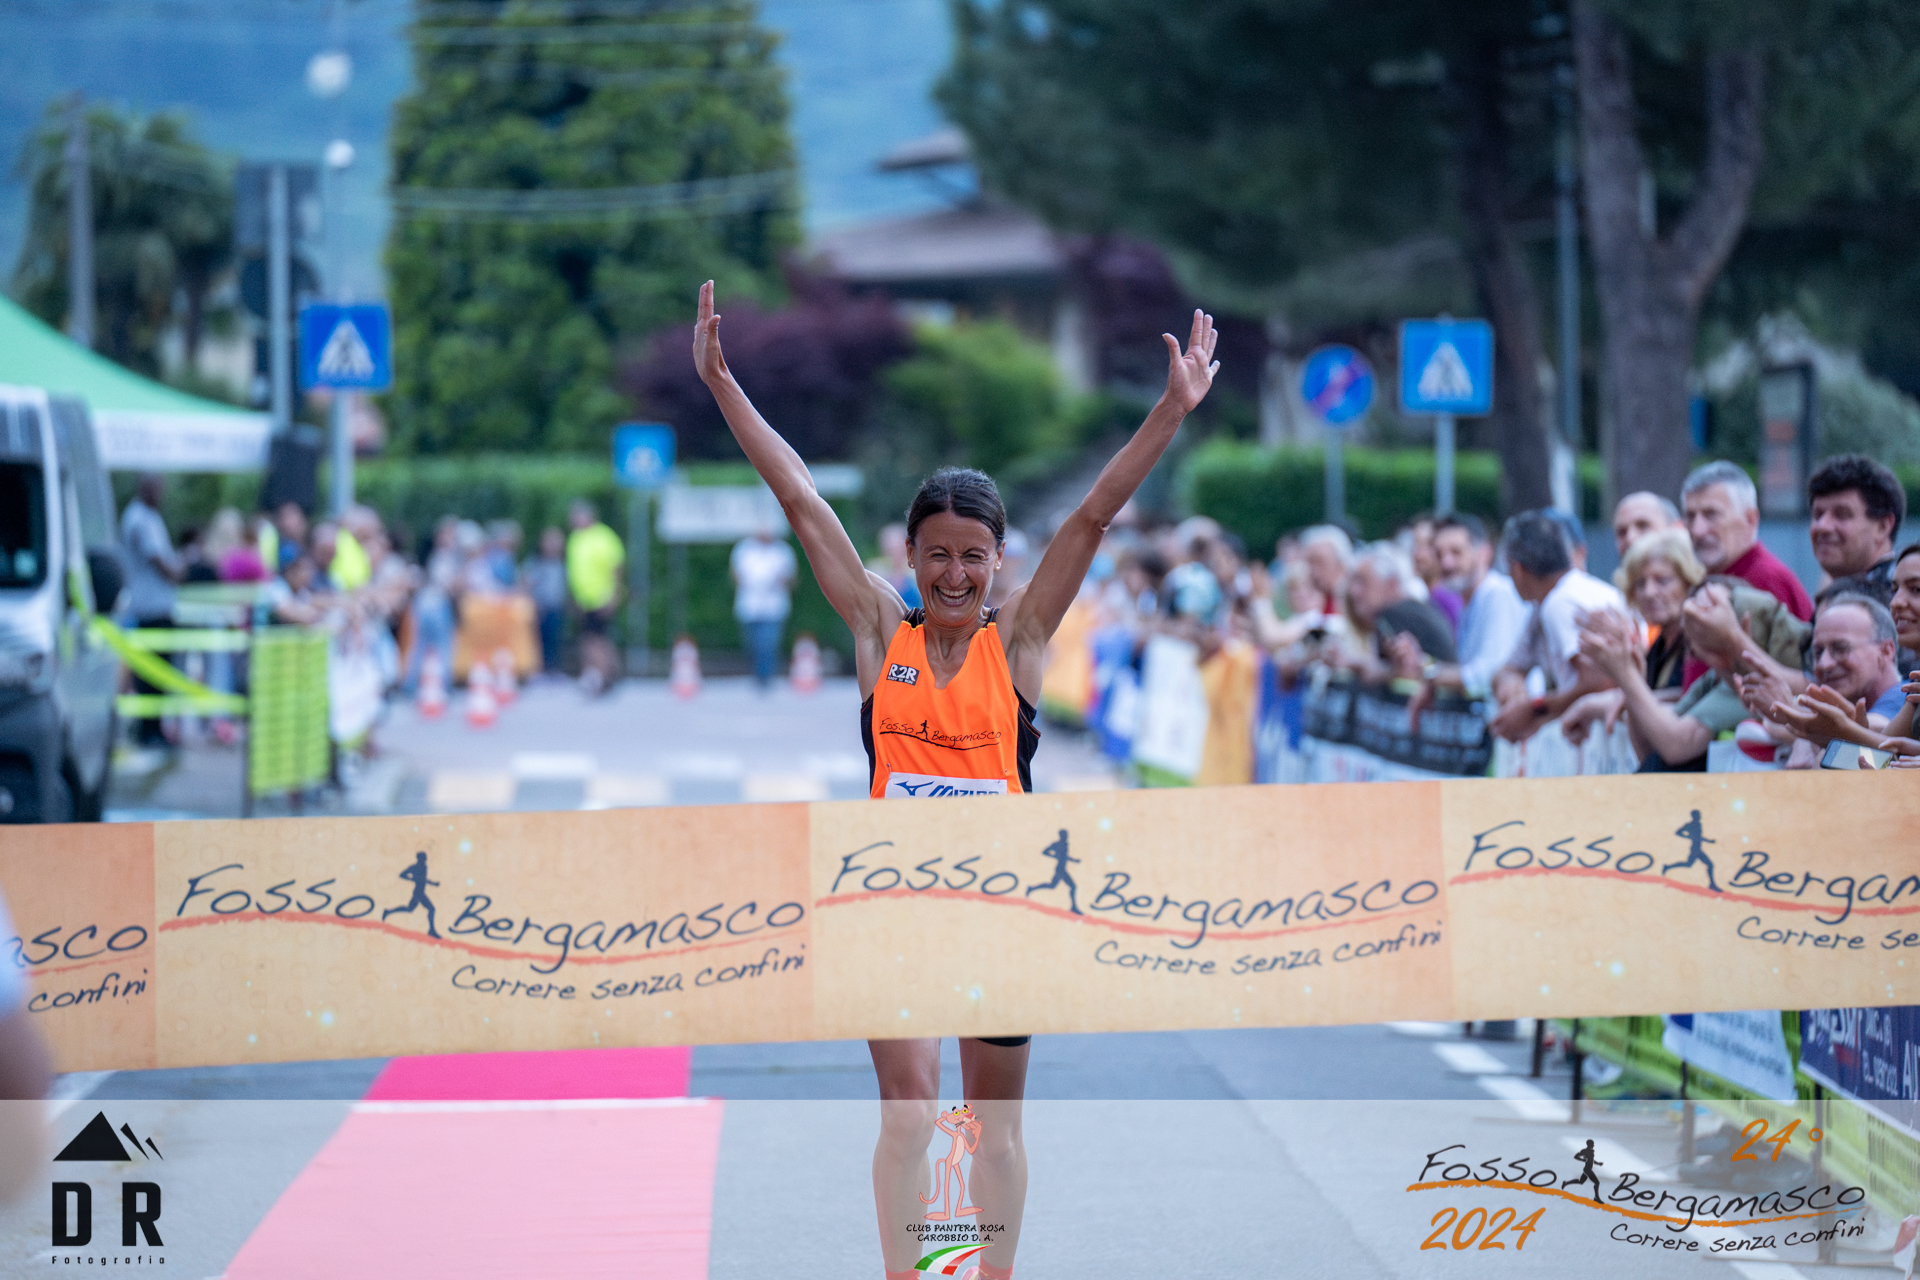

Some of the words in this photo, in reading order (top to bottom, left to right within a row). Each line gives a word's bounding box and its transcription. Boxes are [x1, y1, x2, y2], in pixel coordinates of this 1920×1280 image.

[888, 663, 917, 682] R2R
[879, 717, 914, 734] Fosso
[931, 730, 1002, 747] Bergamasco
[1465, 821, 1655, 873] Fosso
[176, 863, 376, 919] Fosso
[447, 894, 805, 974] Bergamasco
[831, 841, 1020, 896] Fosso
[1088, 872, 1440, 949] Bergamasco
[1095, 939, 1216, 976] Correre
[1231, 947, 1321, 975] senza
[1334, 921, 1443, 962] confini
[1737, 916, 1865, 950] Correre
[27, 969, 148, 1013] confini
[451, 964, 577, 999] Correre
[591, 975, 684, 1000] senza
[695, 947, 805, 988] confini
